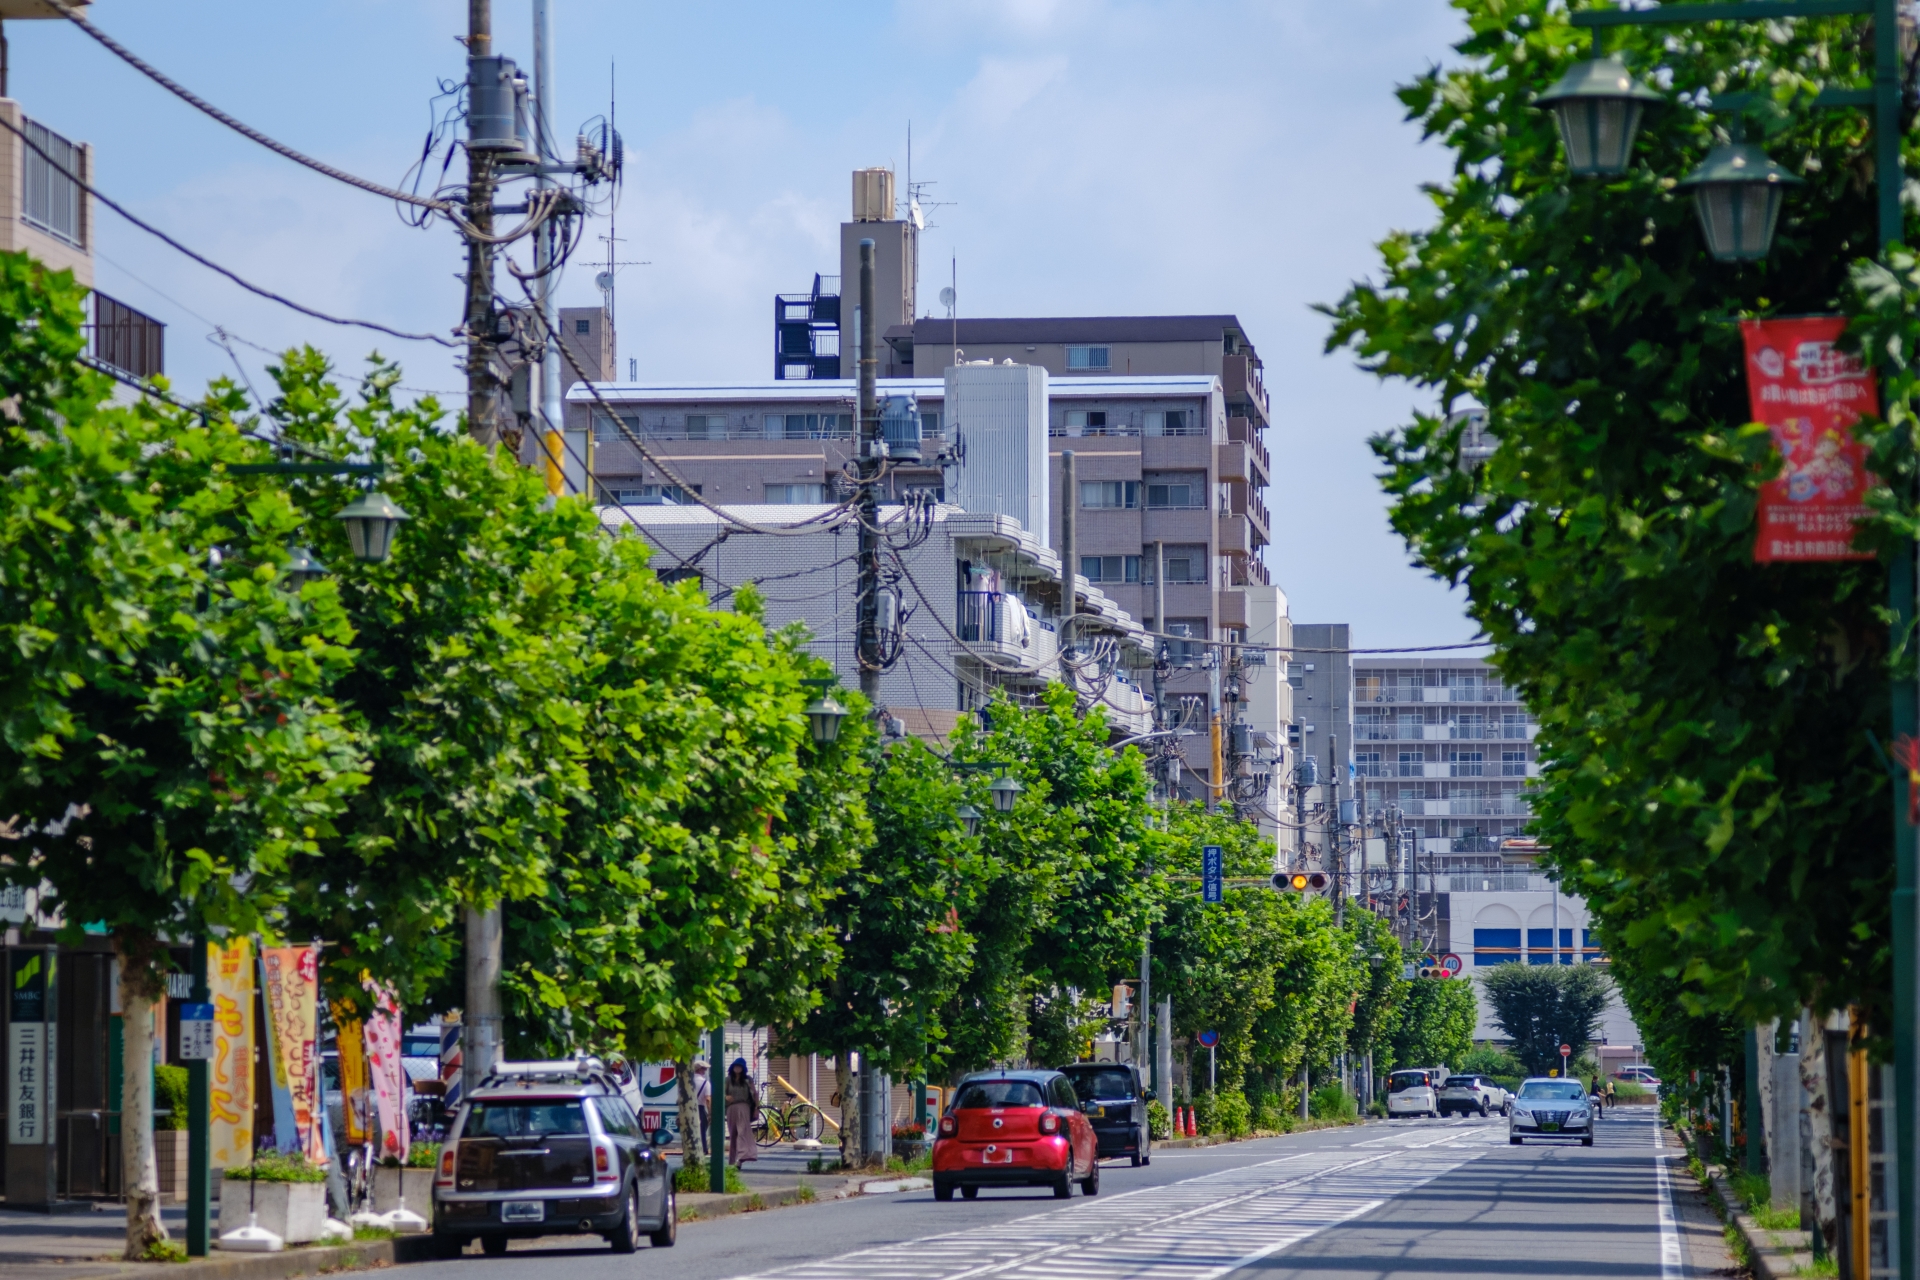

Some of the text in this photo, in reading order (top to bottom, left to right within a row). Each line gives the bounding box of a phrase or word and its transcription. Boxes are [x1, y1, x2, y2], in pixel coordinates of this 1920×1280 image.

[1207, 848, 1218, 901] 押ボタン信号
[1445, 959, 1458, 970] 40
[14, 991, 40, 1000] SMBC
[18, 1029, 36, 1138] 三井住友銀行
